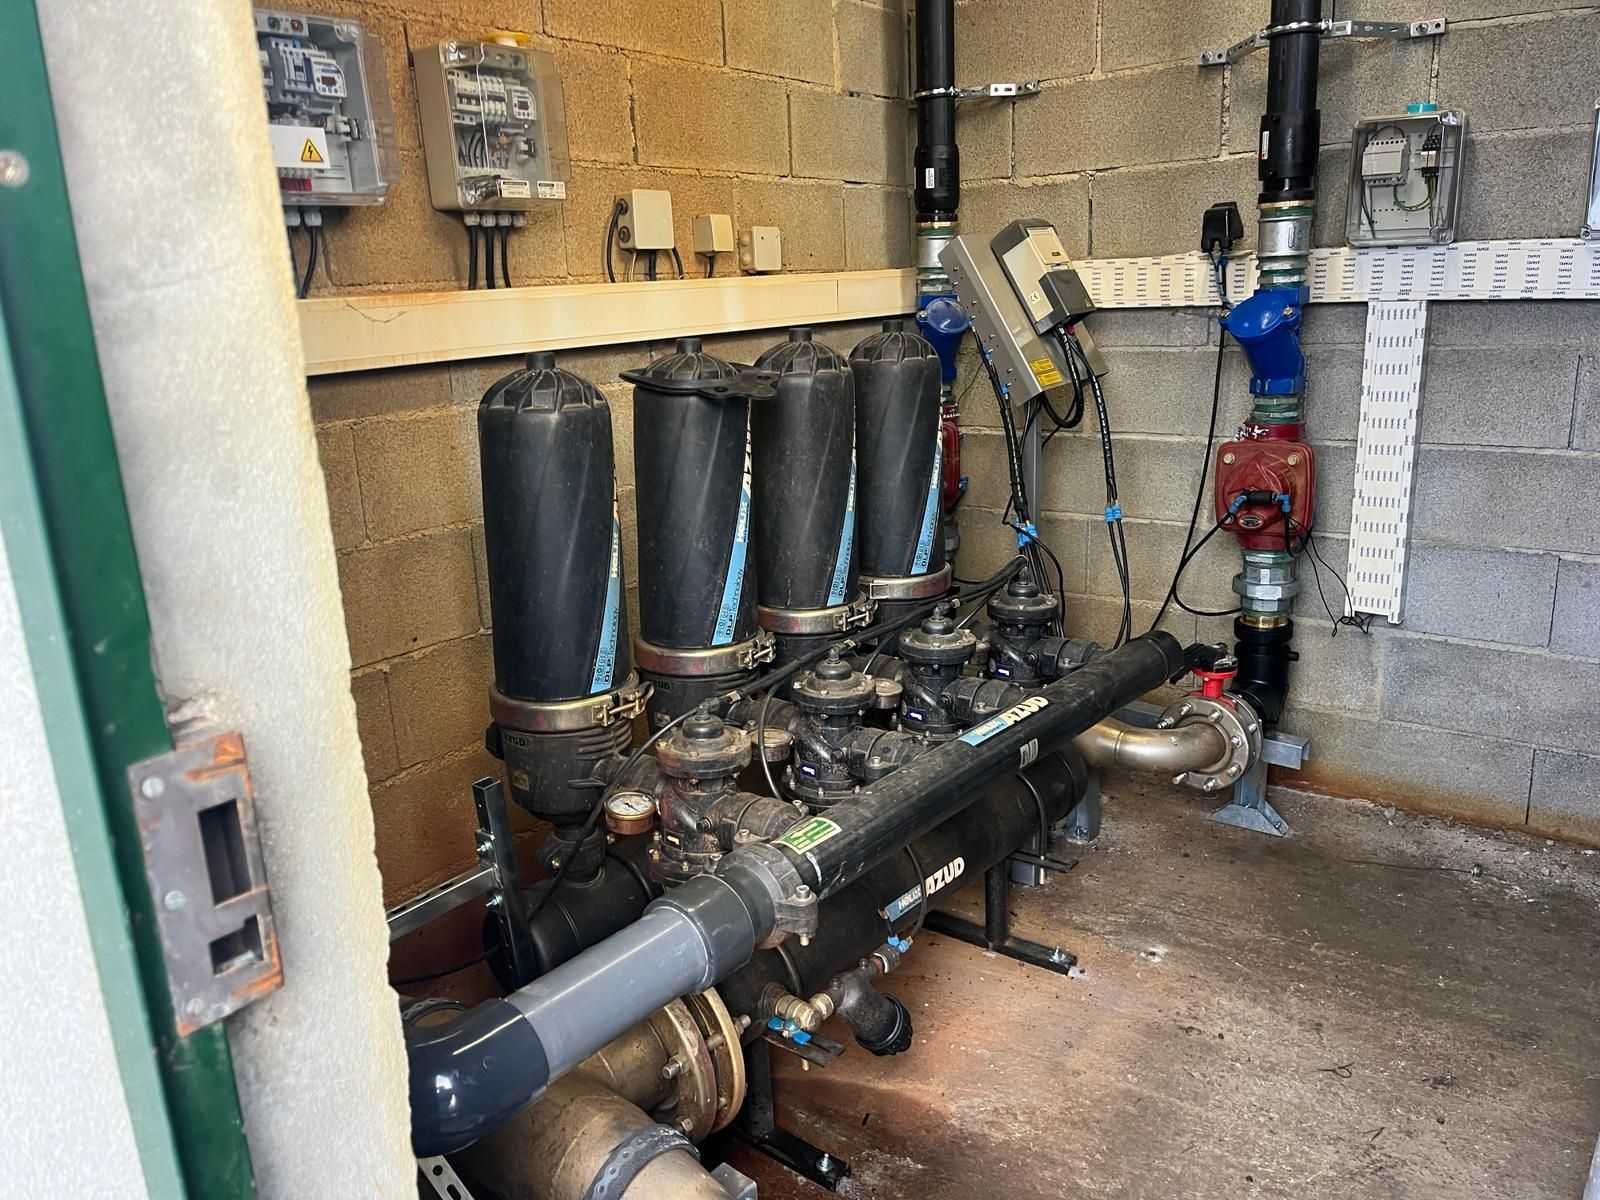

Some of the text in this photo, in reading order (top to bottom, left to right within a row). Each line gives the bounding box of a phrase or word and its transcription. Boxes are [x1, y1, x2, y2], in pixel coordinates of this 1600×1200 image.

[724, 568, 743, 637] DLP Technology
[604, 606, 619, 684] DLP Technology
[1002, 696, 1049, 727] AZUD
[925, 856, 965, 898] AZUD
